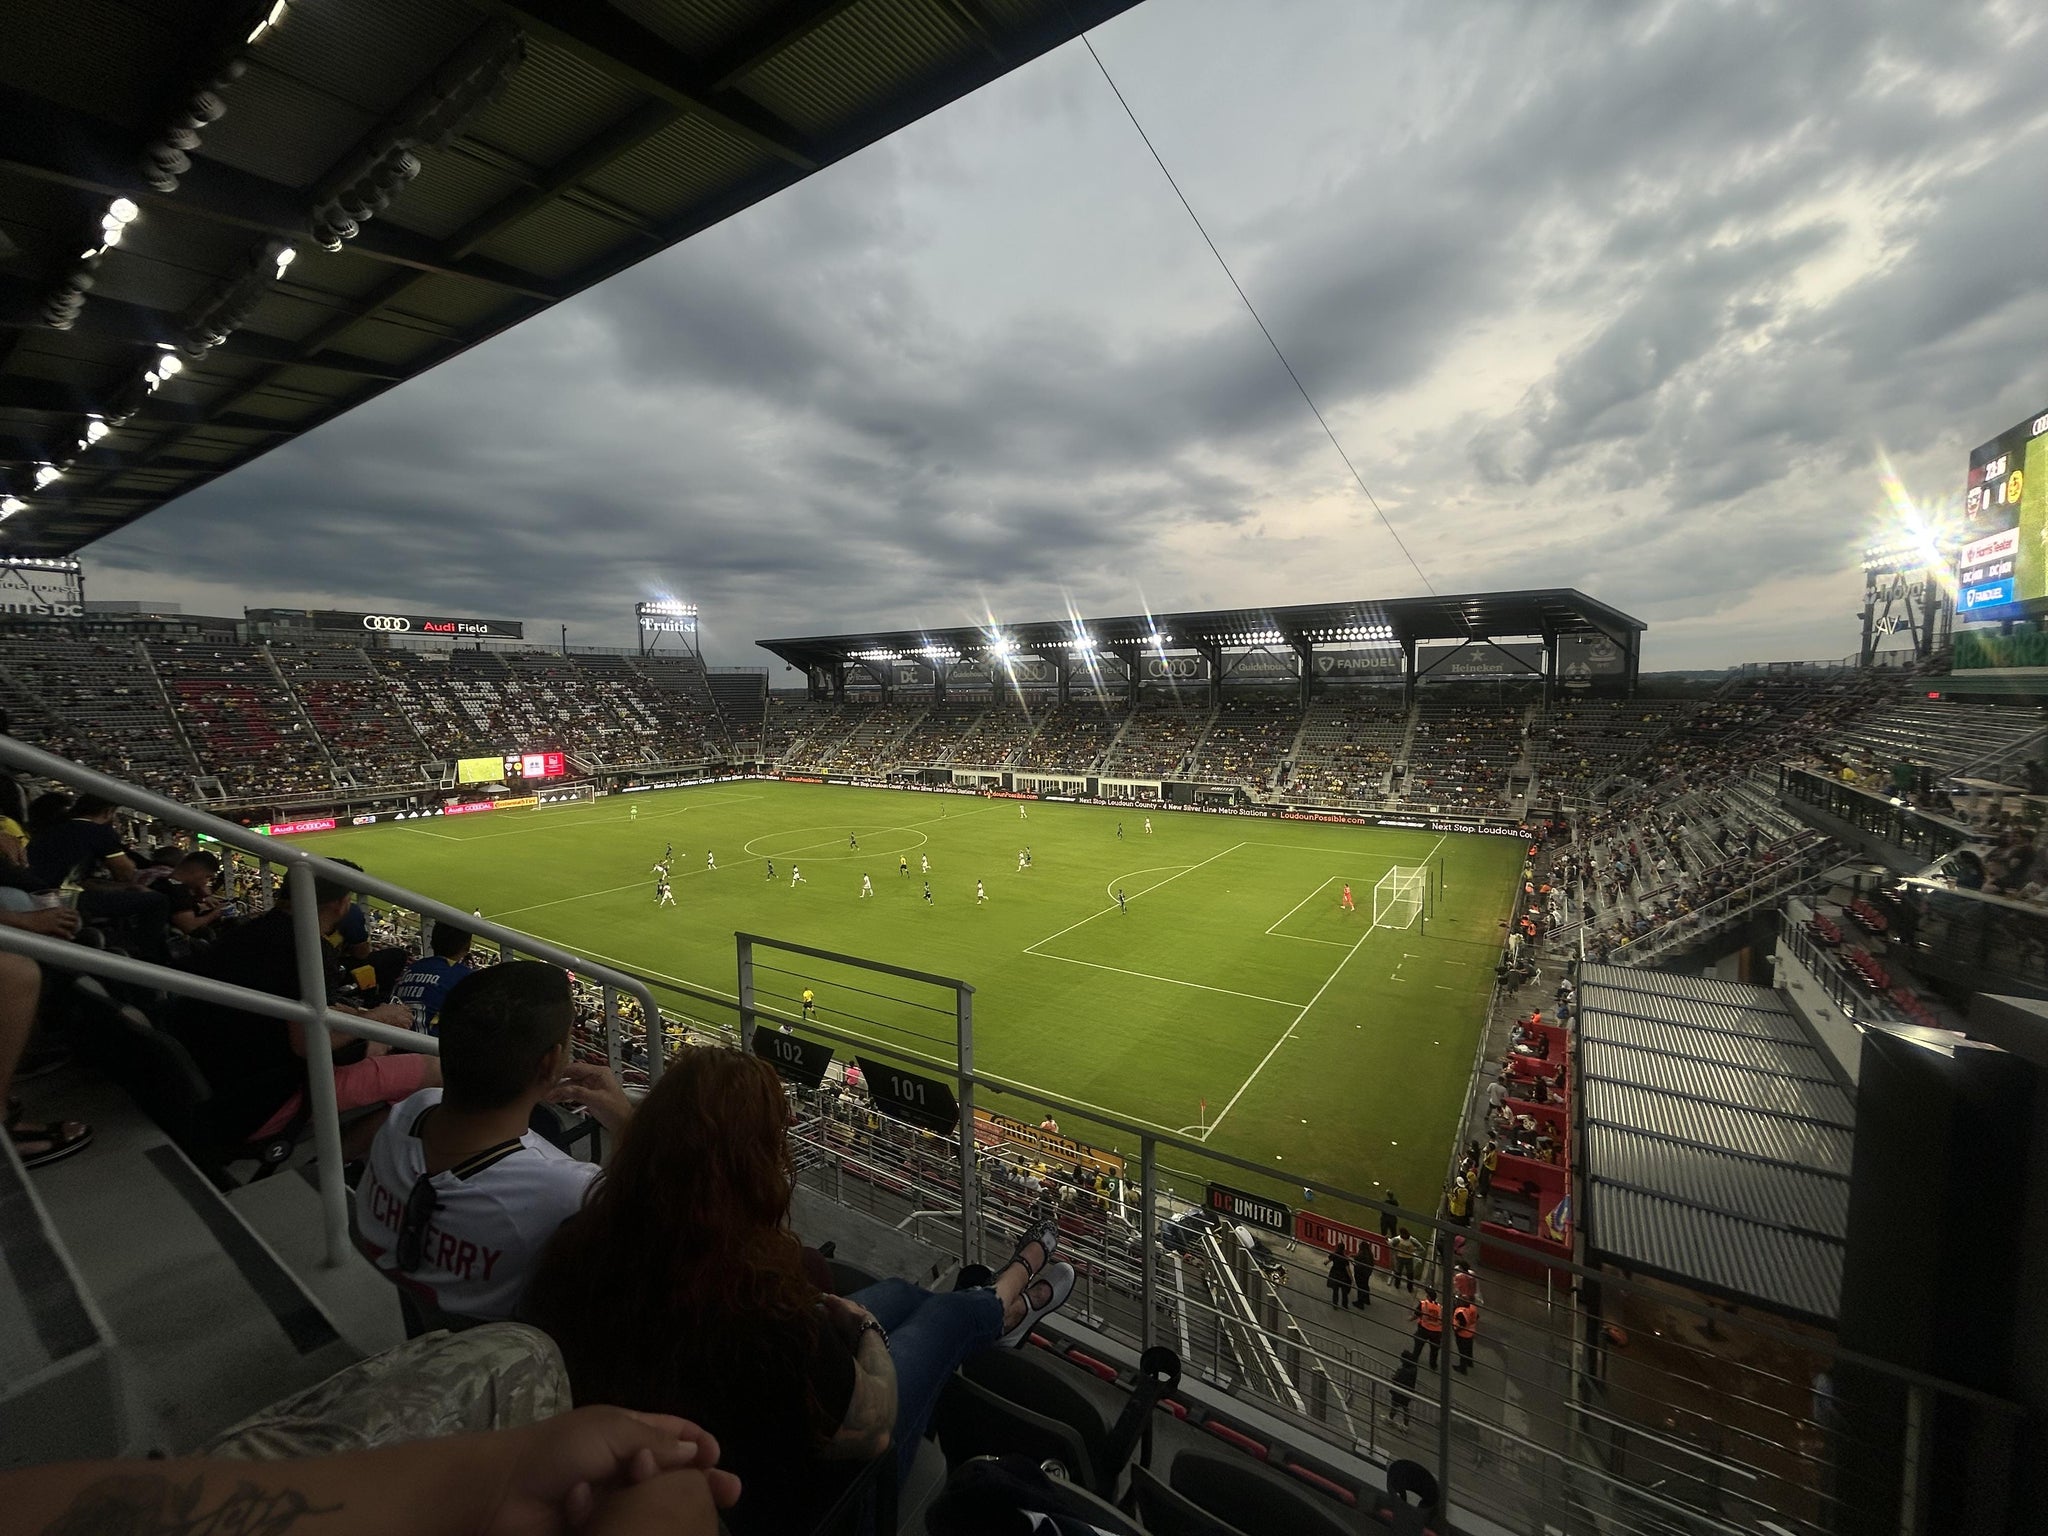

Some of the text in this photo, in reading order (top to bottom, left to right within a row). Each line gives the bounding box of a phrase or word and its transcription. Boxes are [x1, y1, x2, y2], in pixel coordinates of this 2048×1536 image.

[424, 621, 488, 633] Audi Field
[641, 618, 696, 633] Fruitist
[1337, 657, 1396, 669] FANDUEL
[1451, 663, 1503, 673] Heineken
[1134, 801, 1157, 810] County
[1202, 805, 1217, 813] Line
[1218, 807, 1239, 815] Metro
[1239, 808, 1268, 817] Stations
[1280, 811, 1365, 825] LoudounPossible.com
[273, 825, 294, 833] Audi
[1432, 822, 1452, 831] Next
[1478, 825, 1518, 836] Loudoun
[773, 1038, 804, 1065] 102
[891, 1076, 925, 1105] 101
[1234, 1198, 1283, 1228] UNITED
